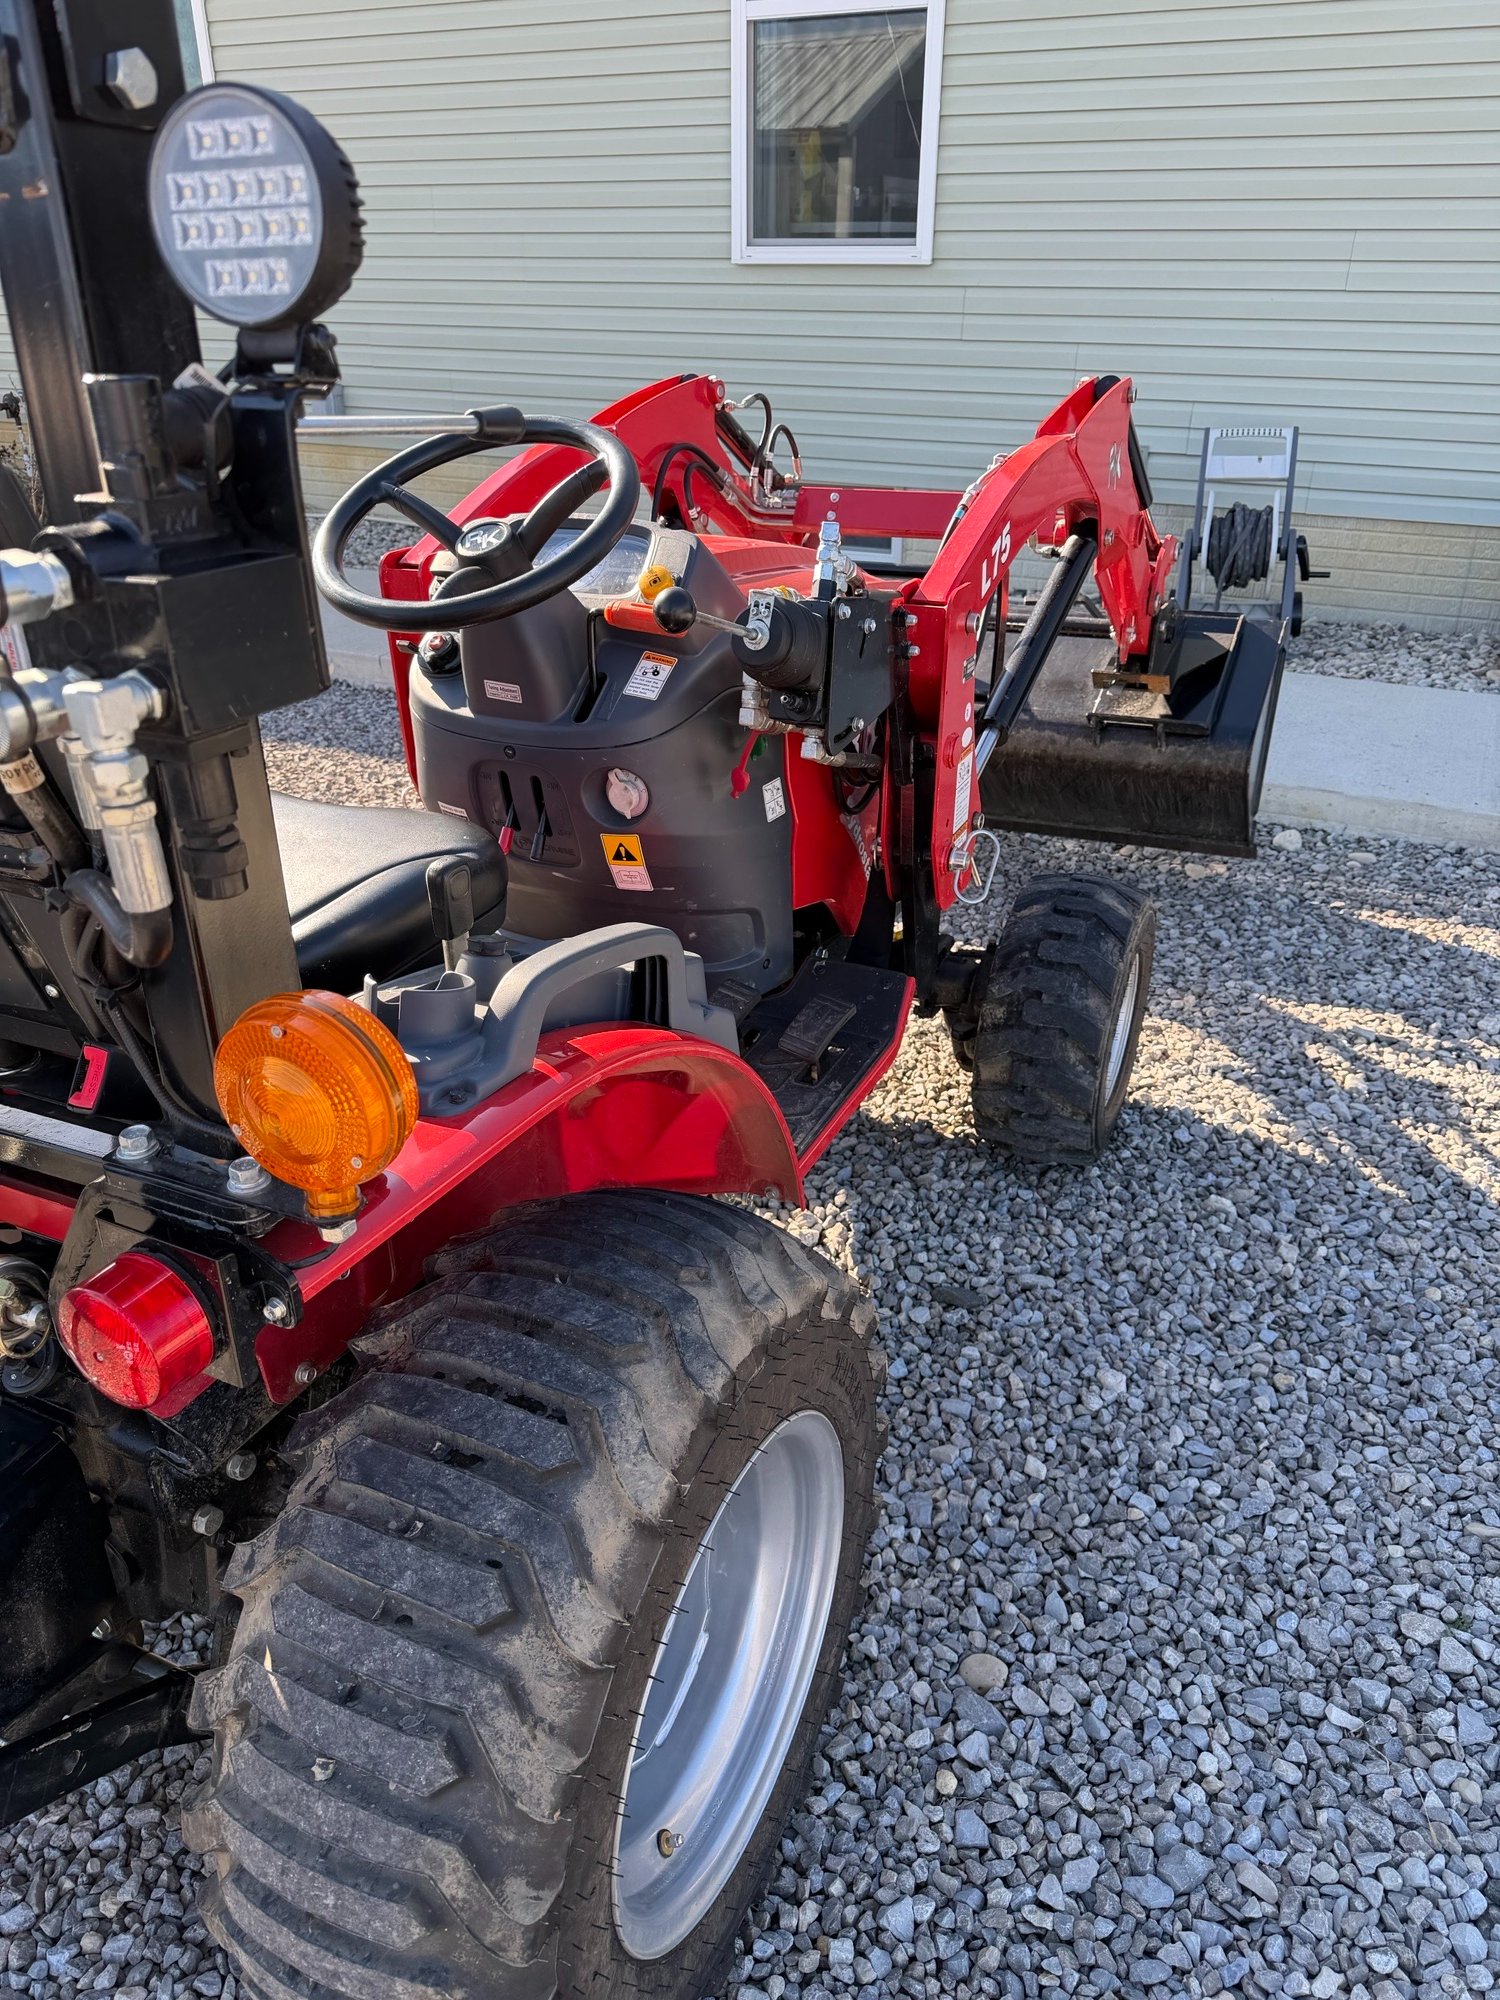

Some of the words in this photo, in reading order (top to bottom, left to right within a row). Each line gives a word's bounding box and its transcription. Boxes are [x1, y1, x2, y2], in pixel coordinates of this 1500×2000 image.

[465, 528, 501, 549] RK
[651, 656, 674, 665] WARNING
[88, 1063, 102, 1094] PRESS
